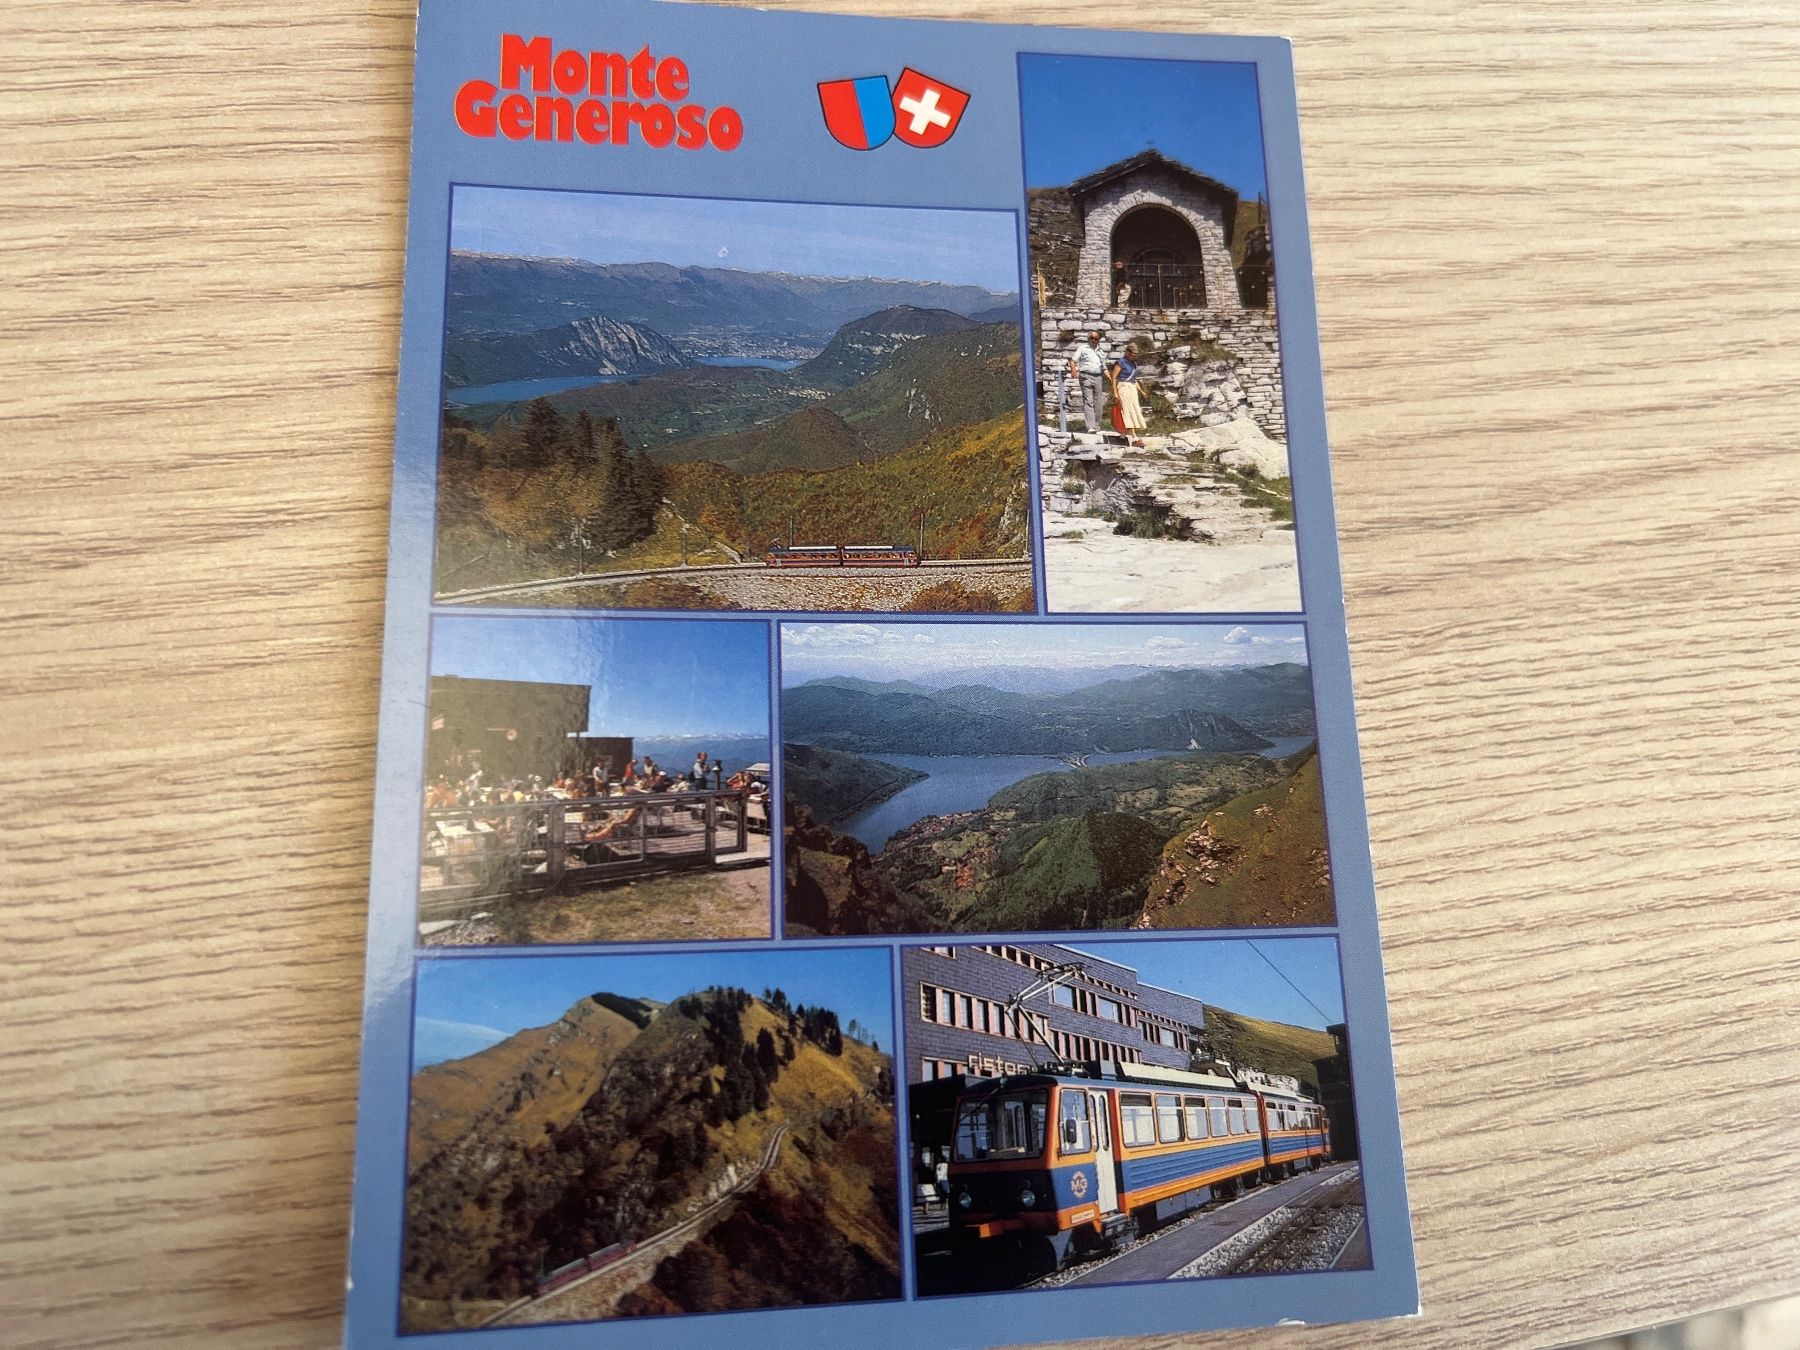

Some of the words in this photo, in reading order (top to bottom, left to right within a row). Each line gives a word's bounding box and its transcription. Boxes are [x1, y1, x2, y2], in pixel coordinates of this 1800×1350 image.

[501, 34, 689, 101] Monte
[455, 80, 743, 151] Generoso
[1071, 1179, 1088, 1194] MG
